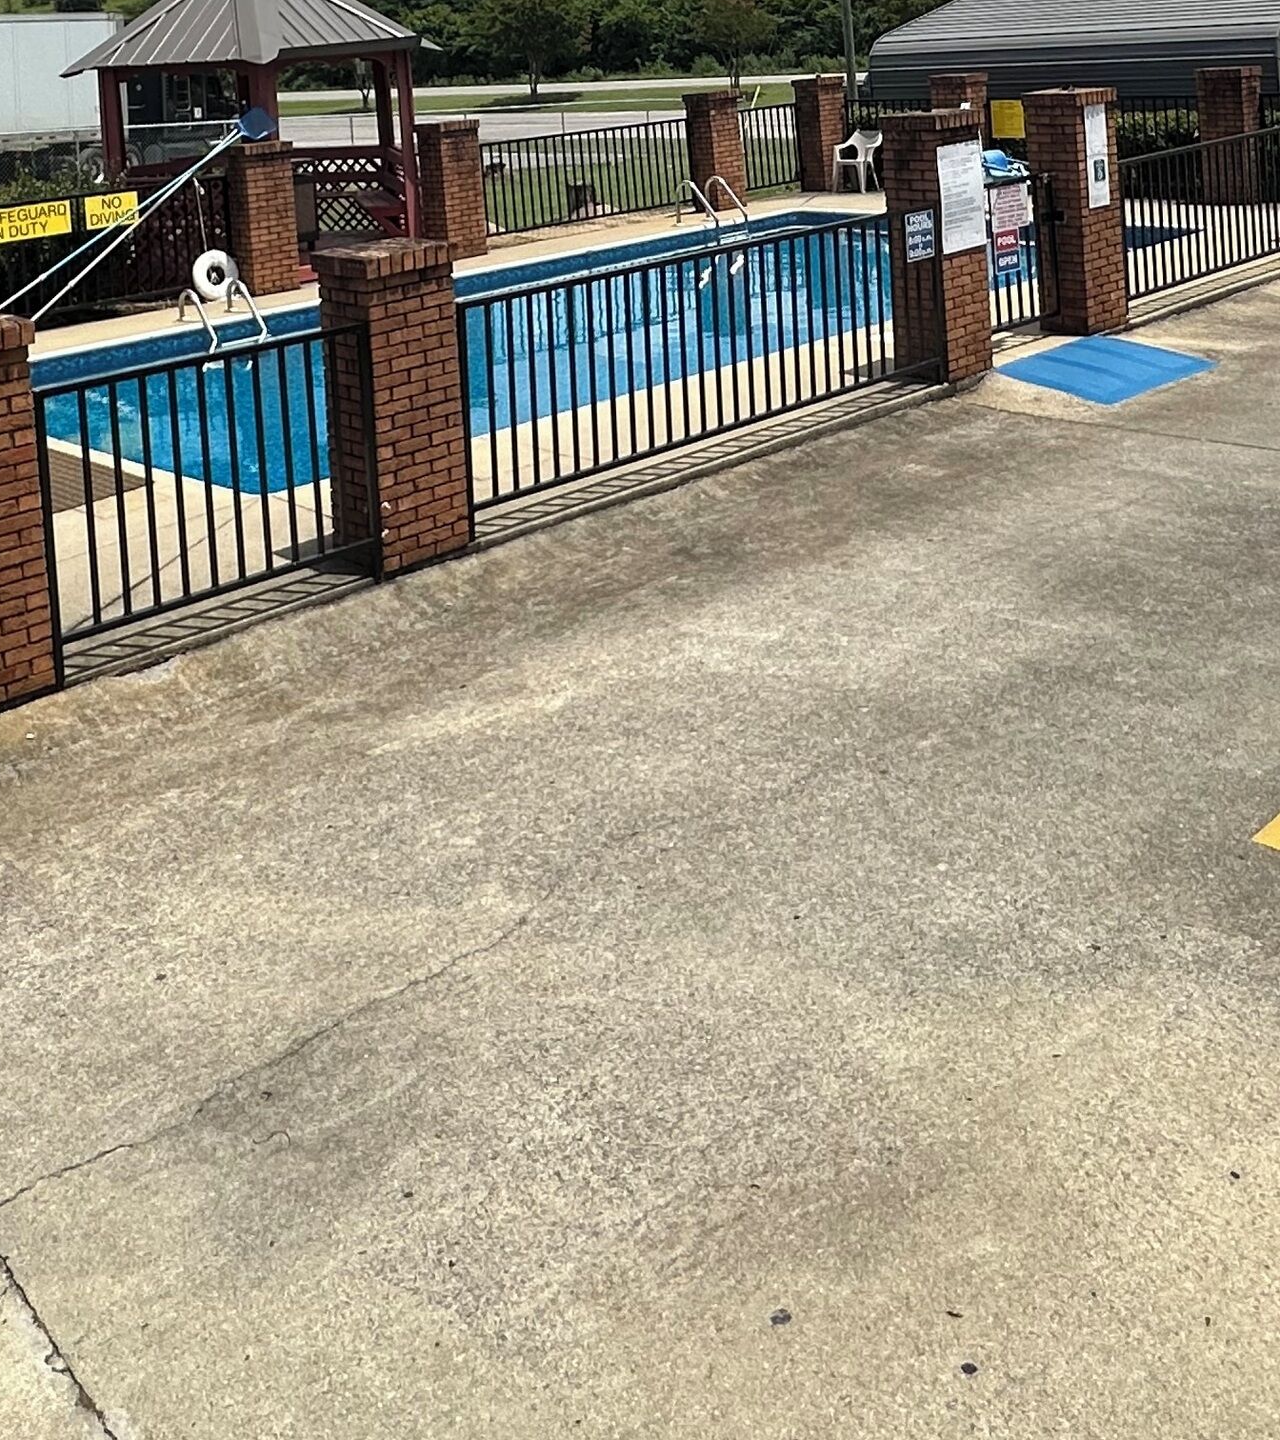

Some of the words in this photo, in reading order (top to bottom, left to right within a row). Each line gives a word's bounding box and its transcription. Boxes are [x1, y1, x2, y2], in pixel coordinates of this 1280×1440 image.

[101, 196, 122, 209] NO
[90, 208, 136, 227] DIVING
[909, 212, 929, 225] POOL
[9, 221, 48, 238] DUTY
